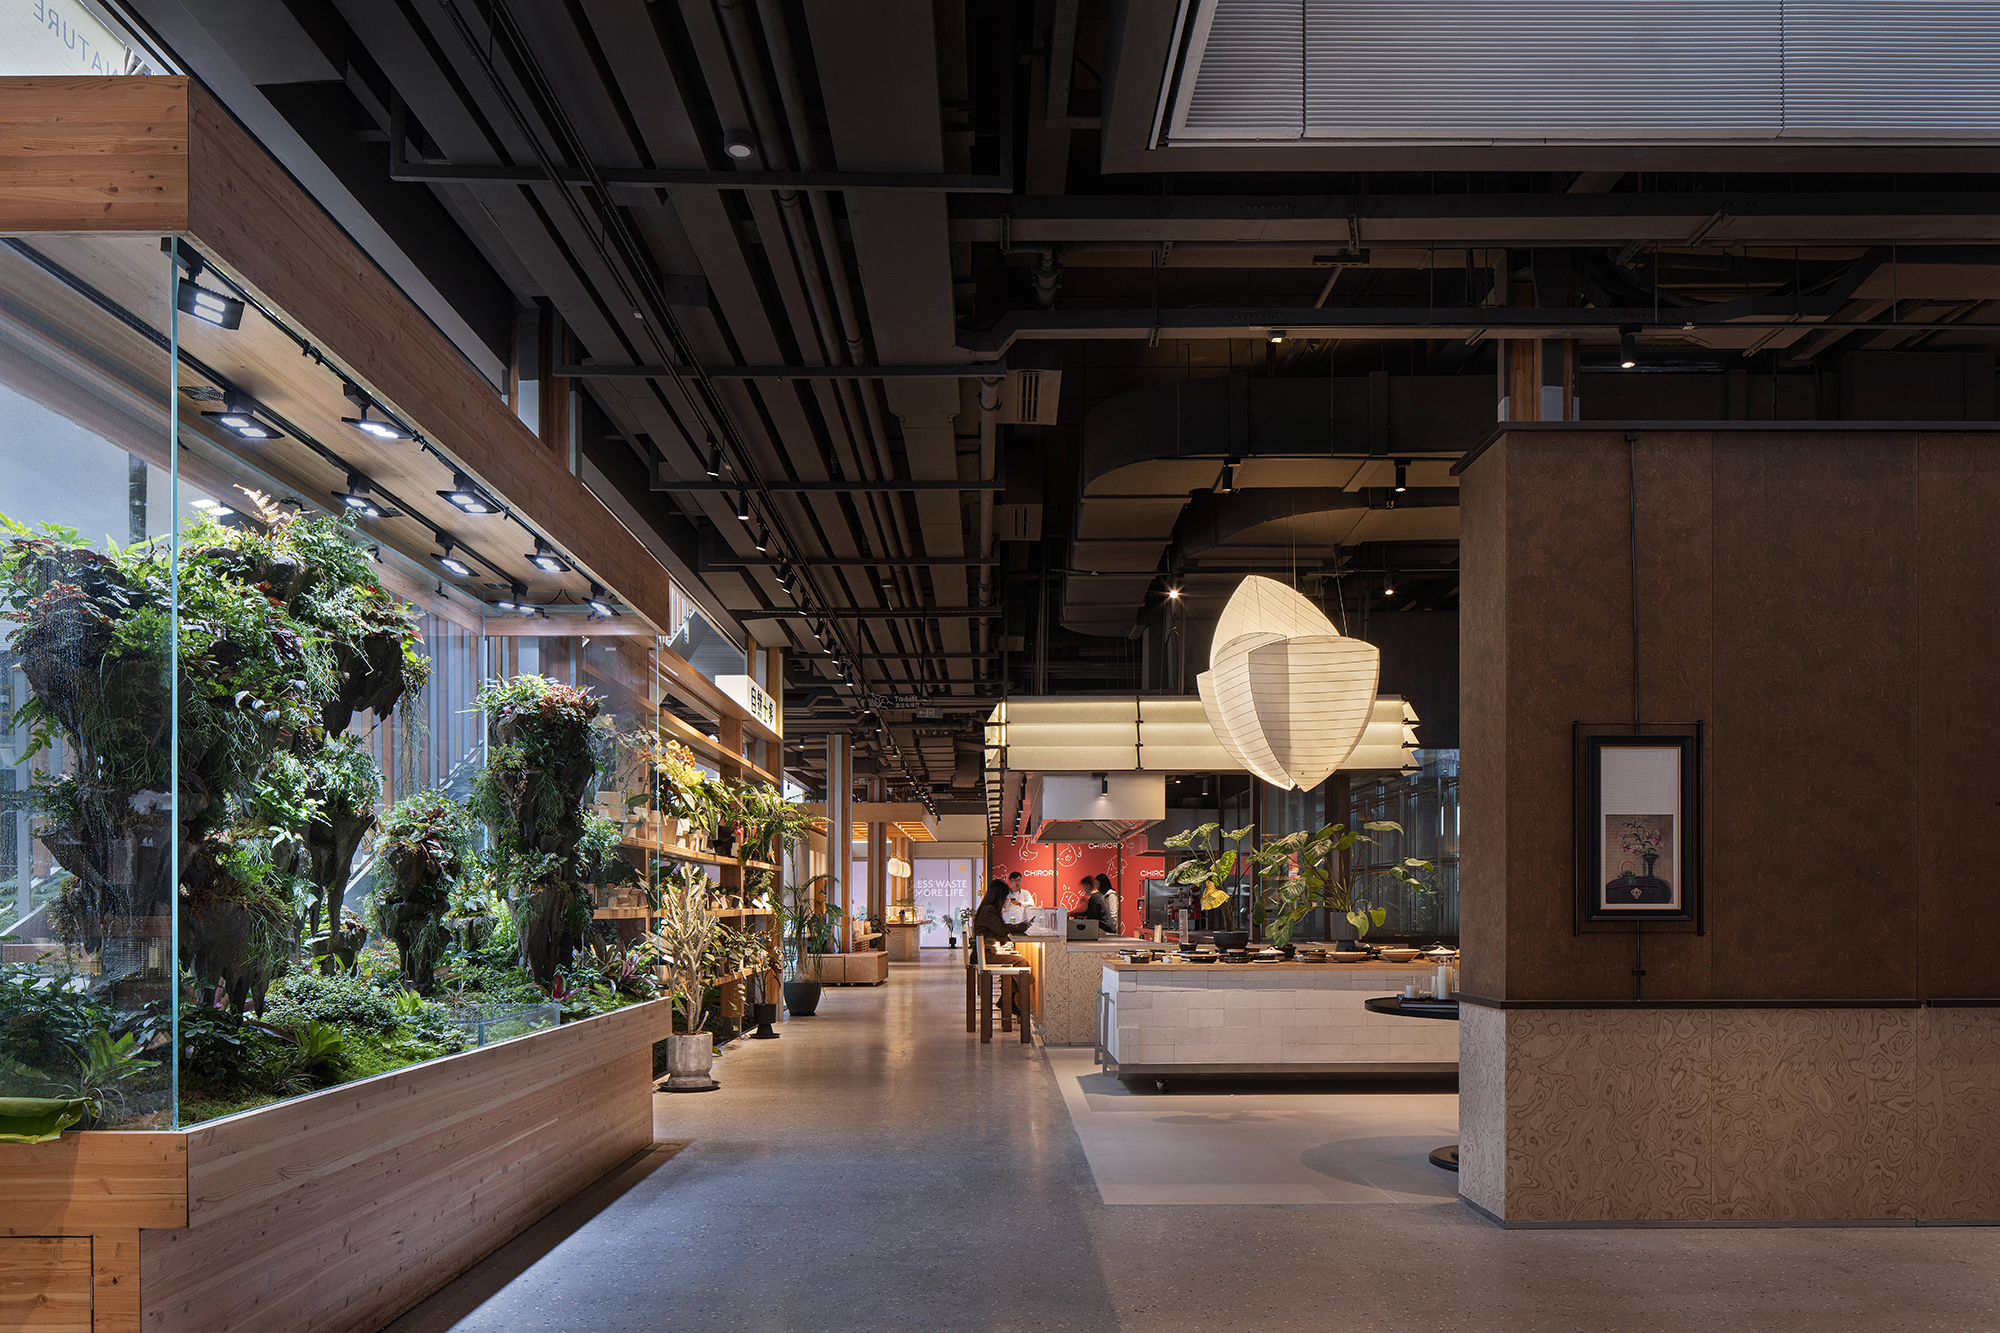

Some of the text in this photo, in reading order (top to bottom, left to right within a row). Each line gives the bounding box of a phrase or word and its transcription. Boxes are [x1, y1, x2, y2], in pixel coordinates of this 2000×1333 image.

[905, 694, 918, 702] Lift
[914, 880, 967, 888] ESS WASTE
[915, 888, 964, 897] MORE LIFE
